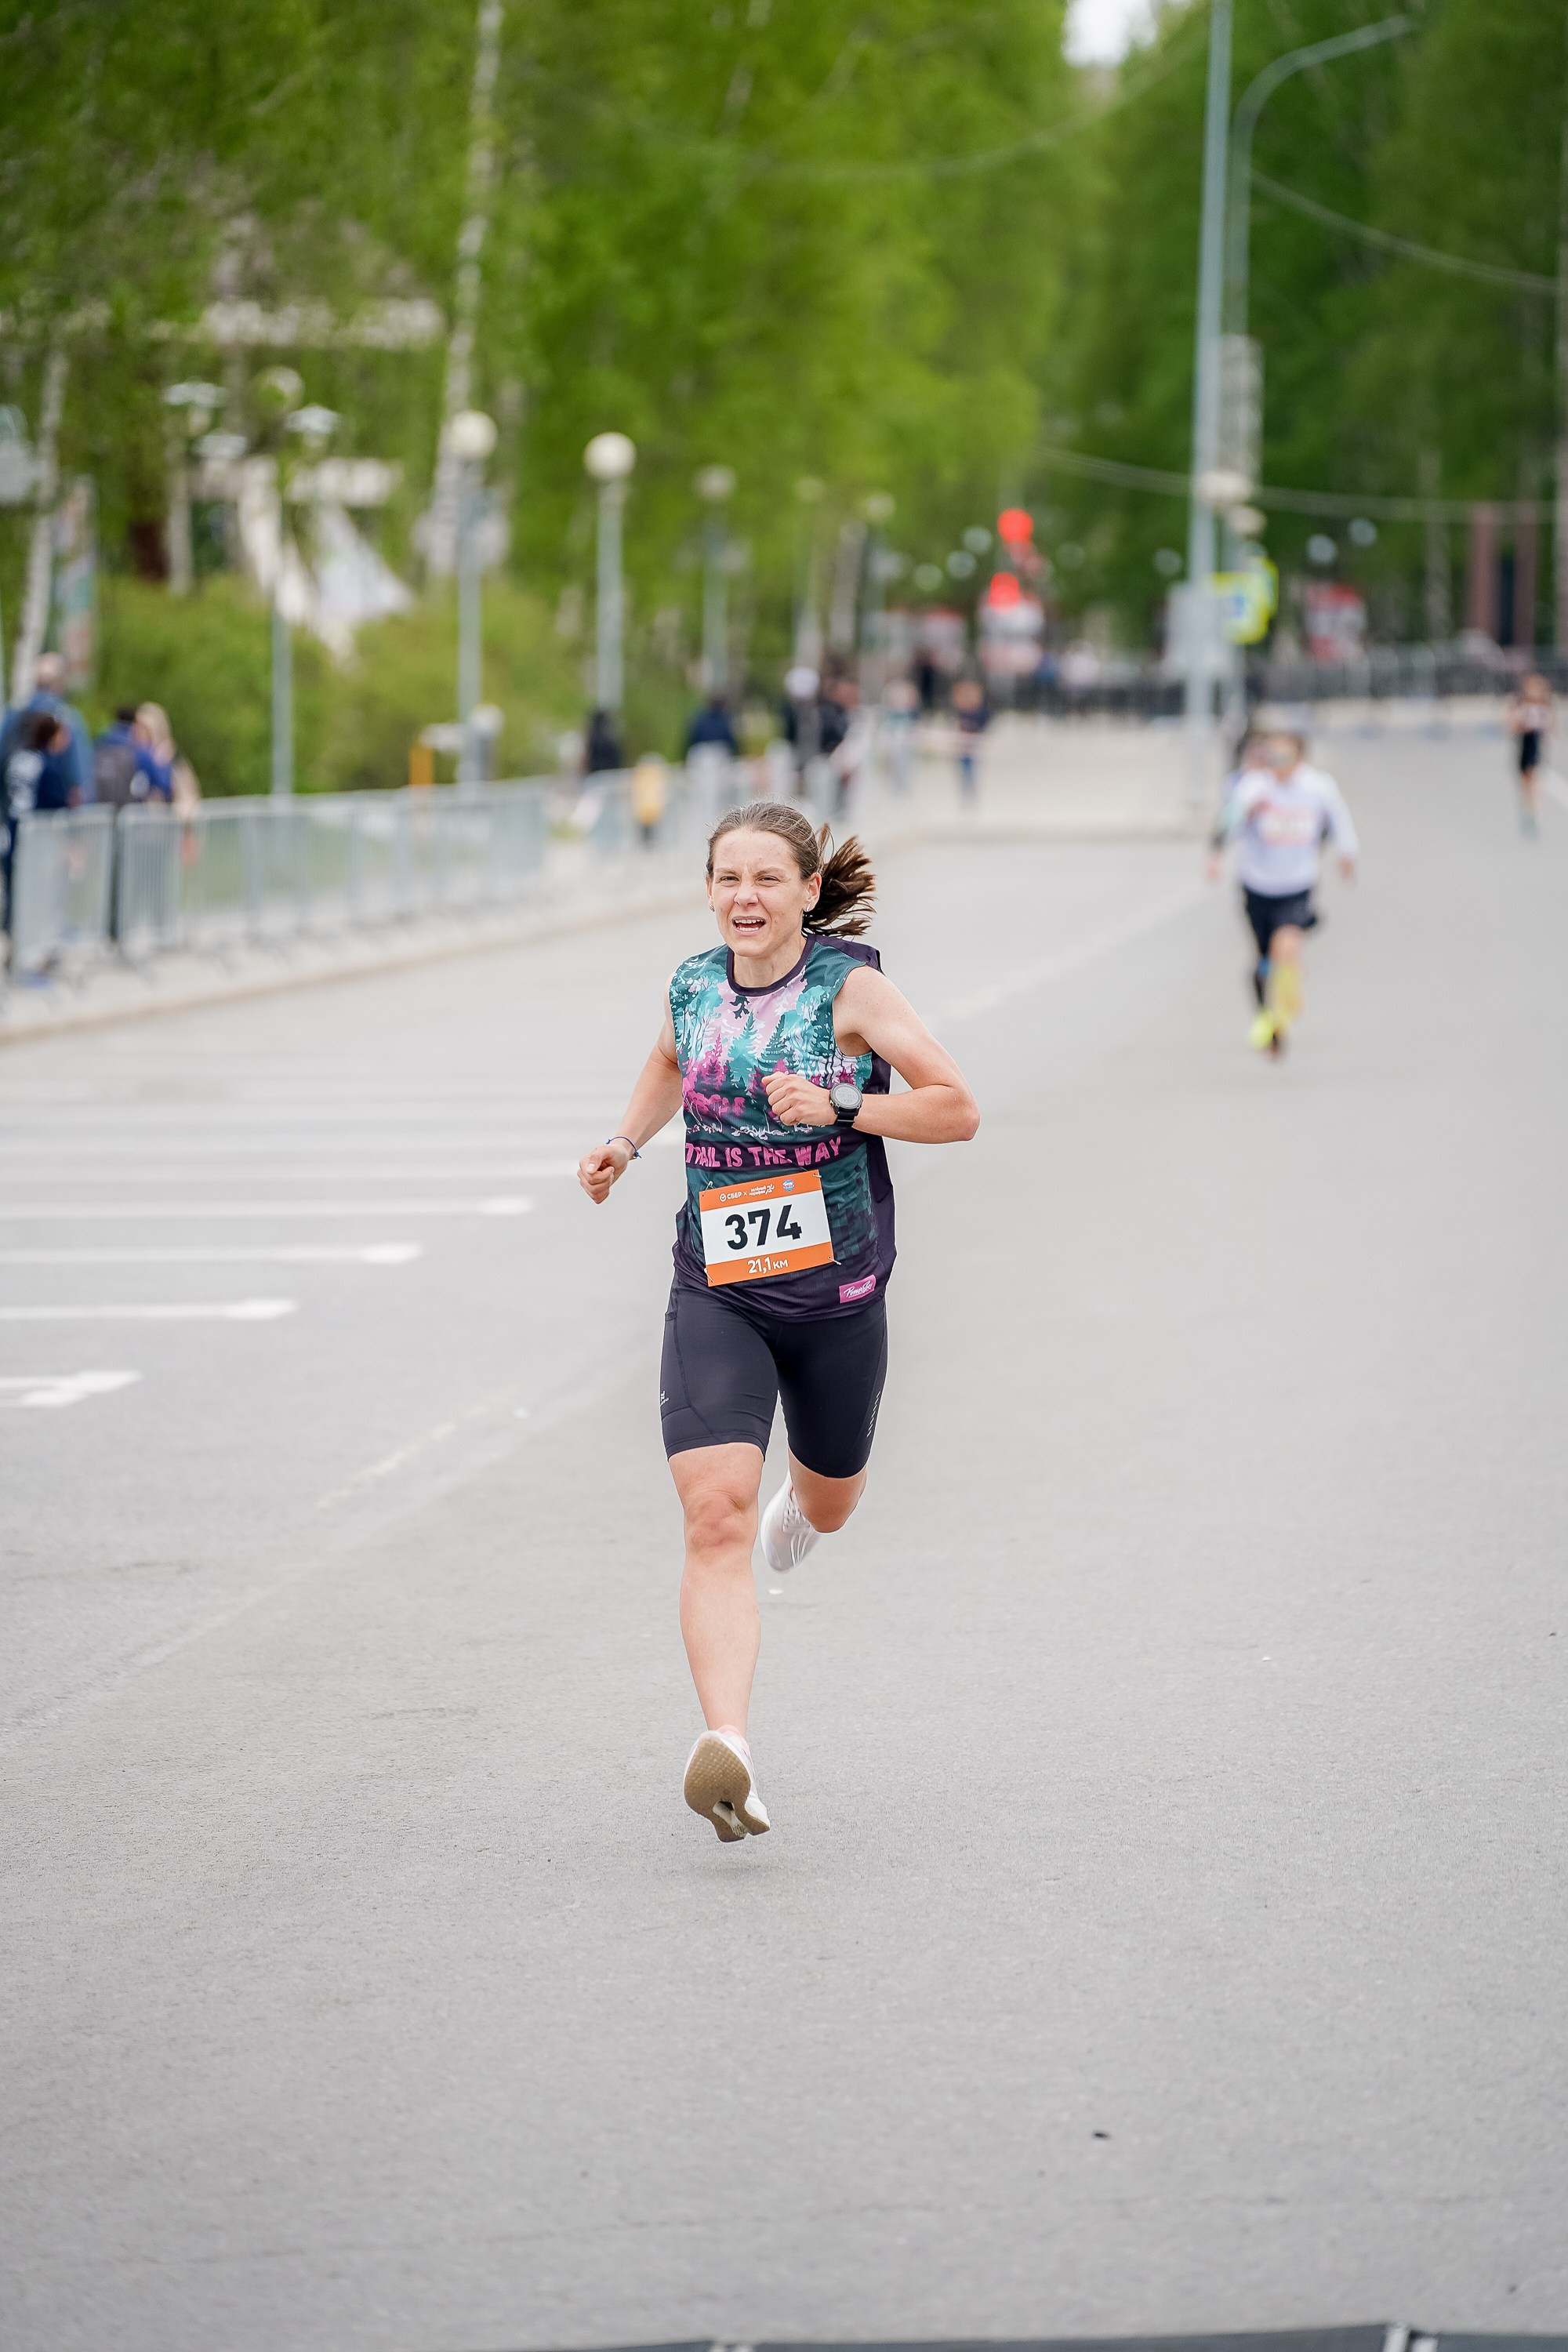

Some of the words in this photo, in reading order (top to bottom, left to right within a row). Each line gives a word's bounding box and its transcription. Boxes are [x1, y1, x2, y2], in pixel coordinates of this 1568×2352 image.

[725, 1147, 743, 1167] IS
[747, 1146, 792, 1167] THE
[794, 1136, 841, 1167] WAY
[727, 1192, 742, 1200] СБЕР
[724, 1203, 803, 1250] 374
[747, 1256, 771, 1274] 21,1
